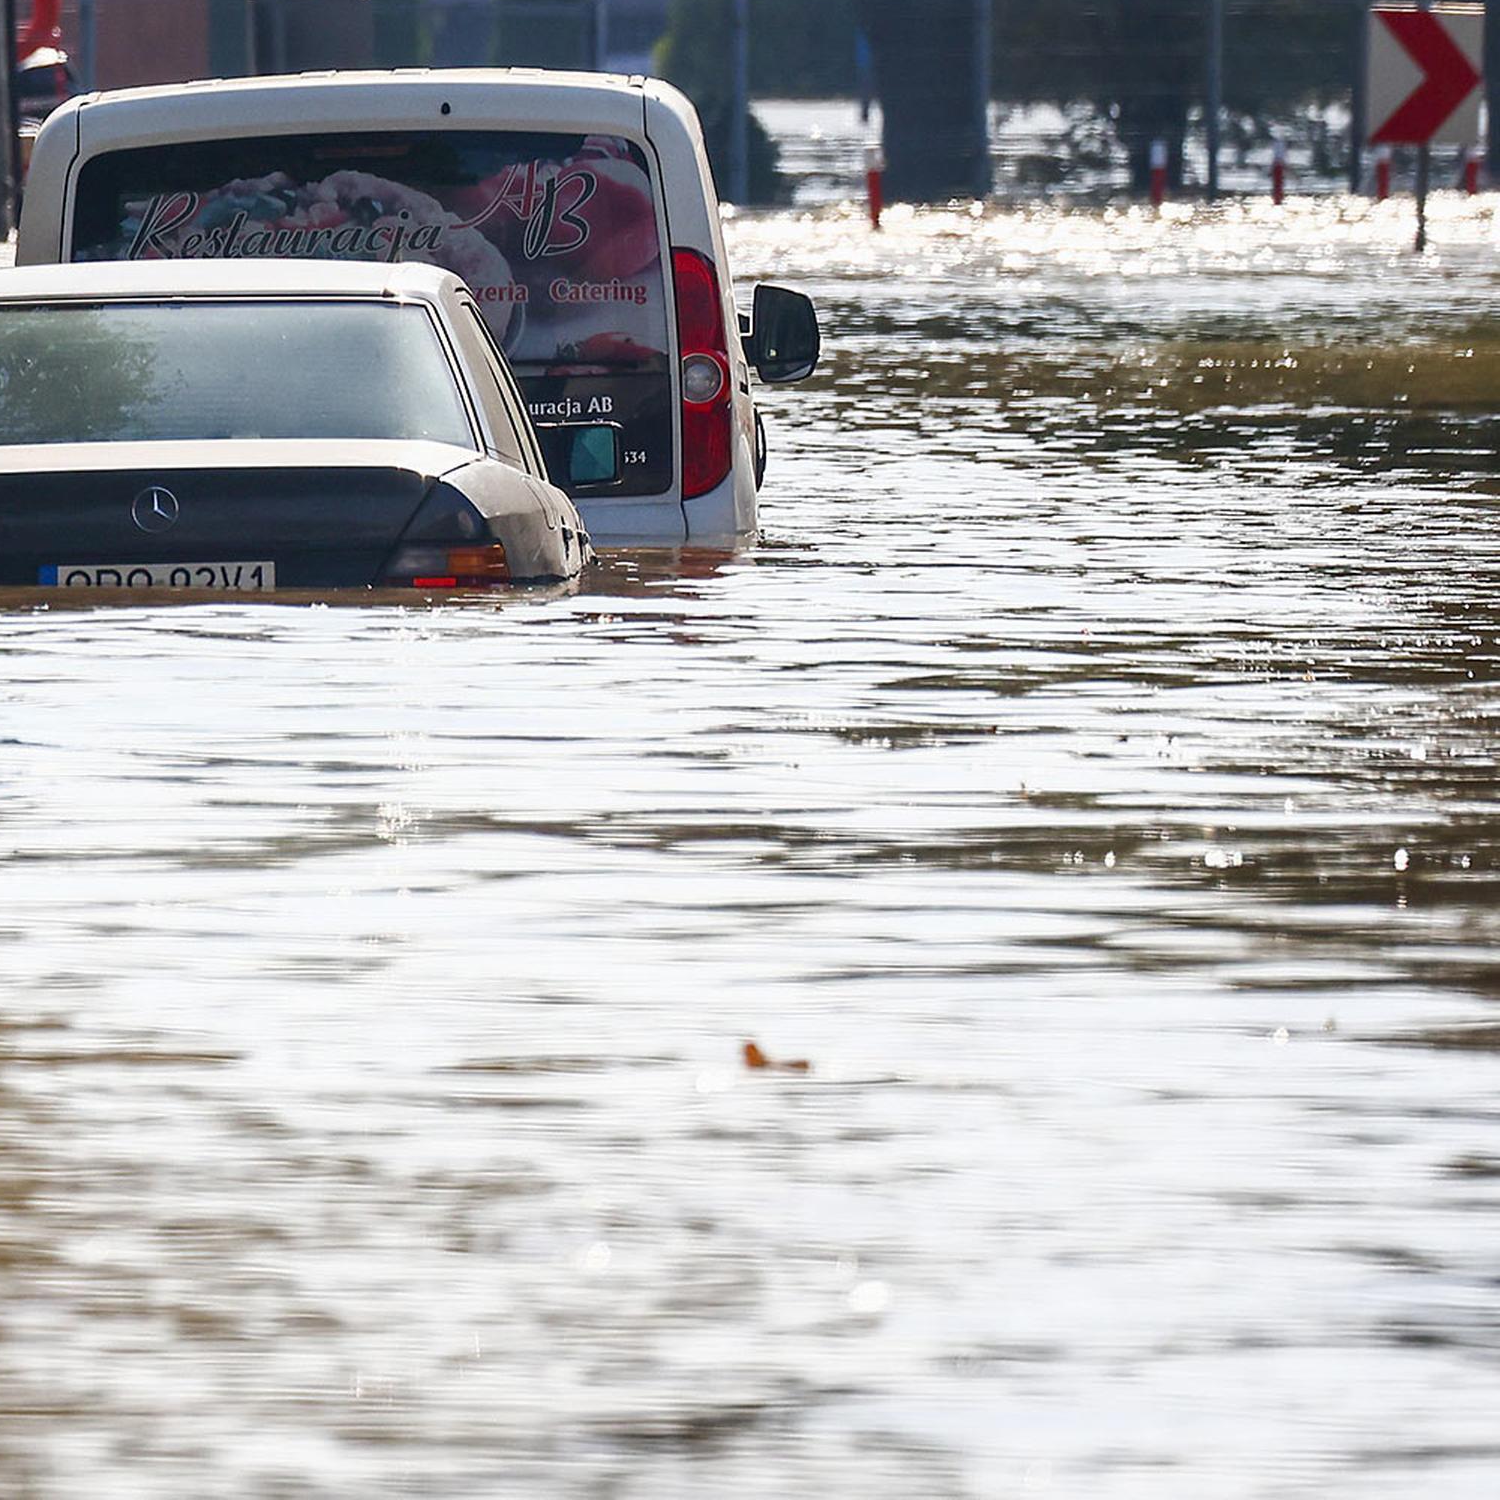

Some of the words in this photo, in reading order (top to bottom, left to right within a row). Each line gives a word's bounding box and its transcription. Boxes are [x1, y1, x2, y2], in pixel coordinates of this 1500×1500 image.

[129, 191, 446, 262] Restauracja
[451, 159, 598, 260] AB
[474, 279, 529, 303] zeria
[551, 276, 649, 306] Catering
[529, 397, 582, 418] uracja
[587, 395, 614, 414] AB
[624, 450, 647, 464] 34
